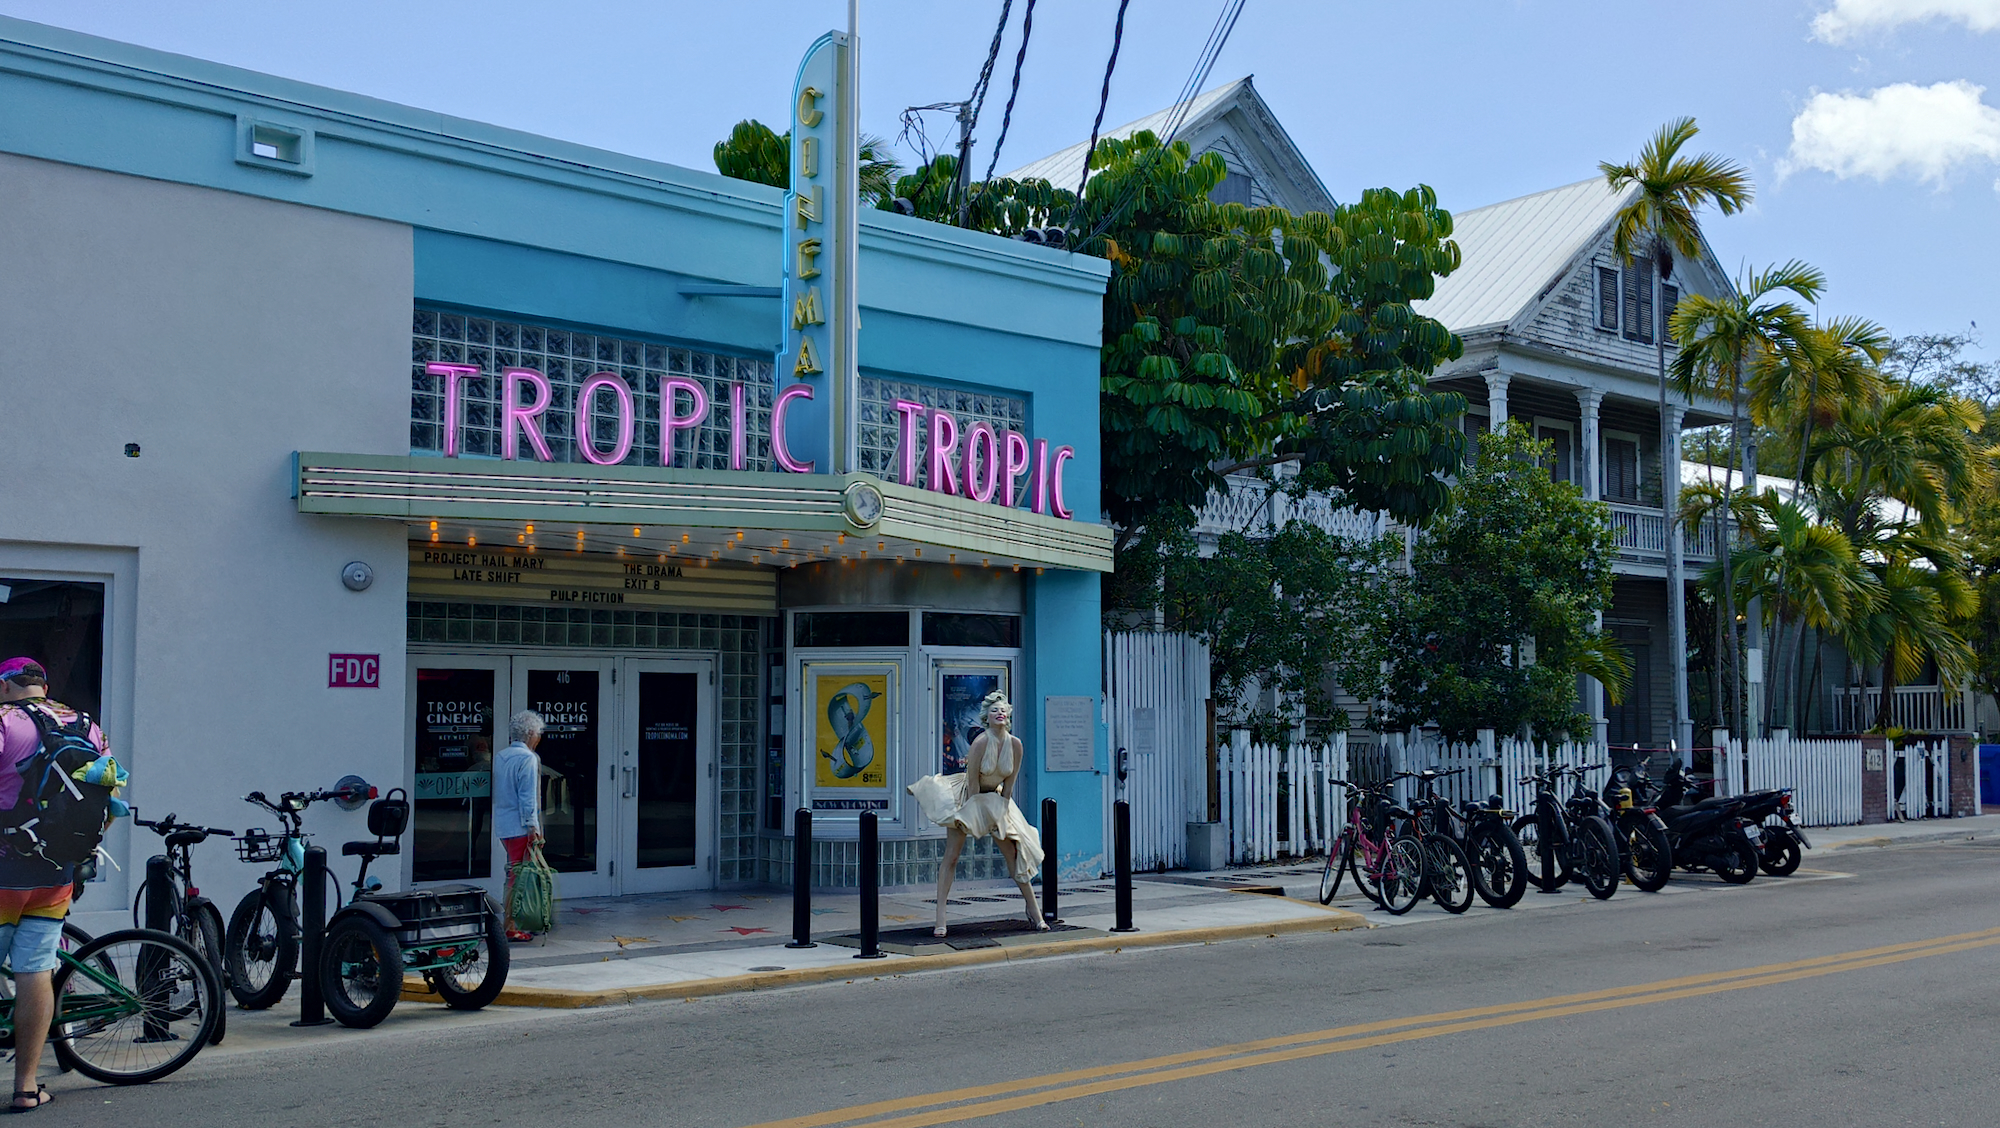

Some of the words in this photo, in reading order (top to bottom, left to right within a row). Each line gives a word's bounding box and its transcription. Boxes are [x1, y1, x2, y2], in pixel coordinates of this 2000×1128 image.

[791, 86, 825, 378] CINEMA
[425, 361, 815, 474] TROPIC
[889, 398, 1075, 520] TROPIC
[424, 552, 477, 565] PROJECT
[482, 554, 508, 567] HAIL
[513, 556, 544, 569] MARY
[454, 569, 482, 581] LATE
[488, 571, 520, 583] SHIFT
[623, 564, 642, 575] THE
[647, 565, 682, 577] DRAMA
[624, 579, 648, 590] EXIT
[653, 580, 660, 590] 8
[551, 590, 578, 602] PULP
[582, 591, 624, 603] FICTION
[331, 658, 377, 684] FDC
[557, 670, 570, 684] 416
[427, 701, 482, 713] TROPIC
[536, 701, 588, 713] TROPIC
[426, 713, 483, 724] CINEMA
[436, 776, 470, 795] OPEN
[813, 801, 838, 810] NOW
